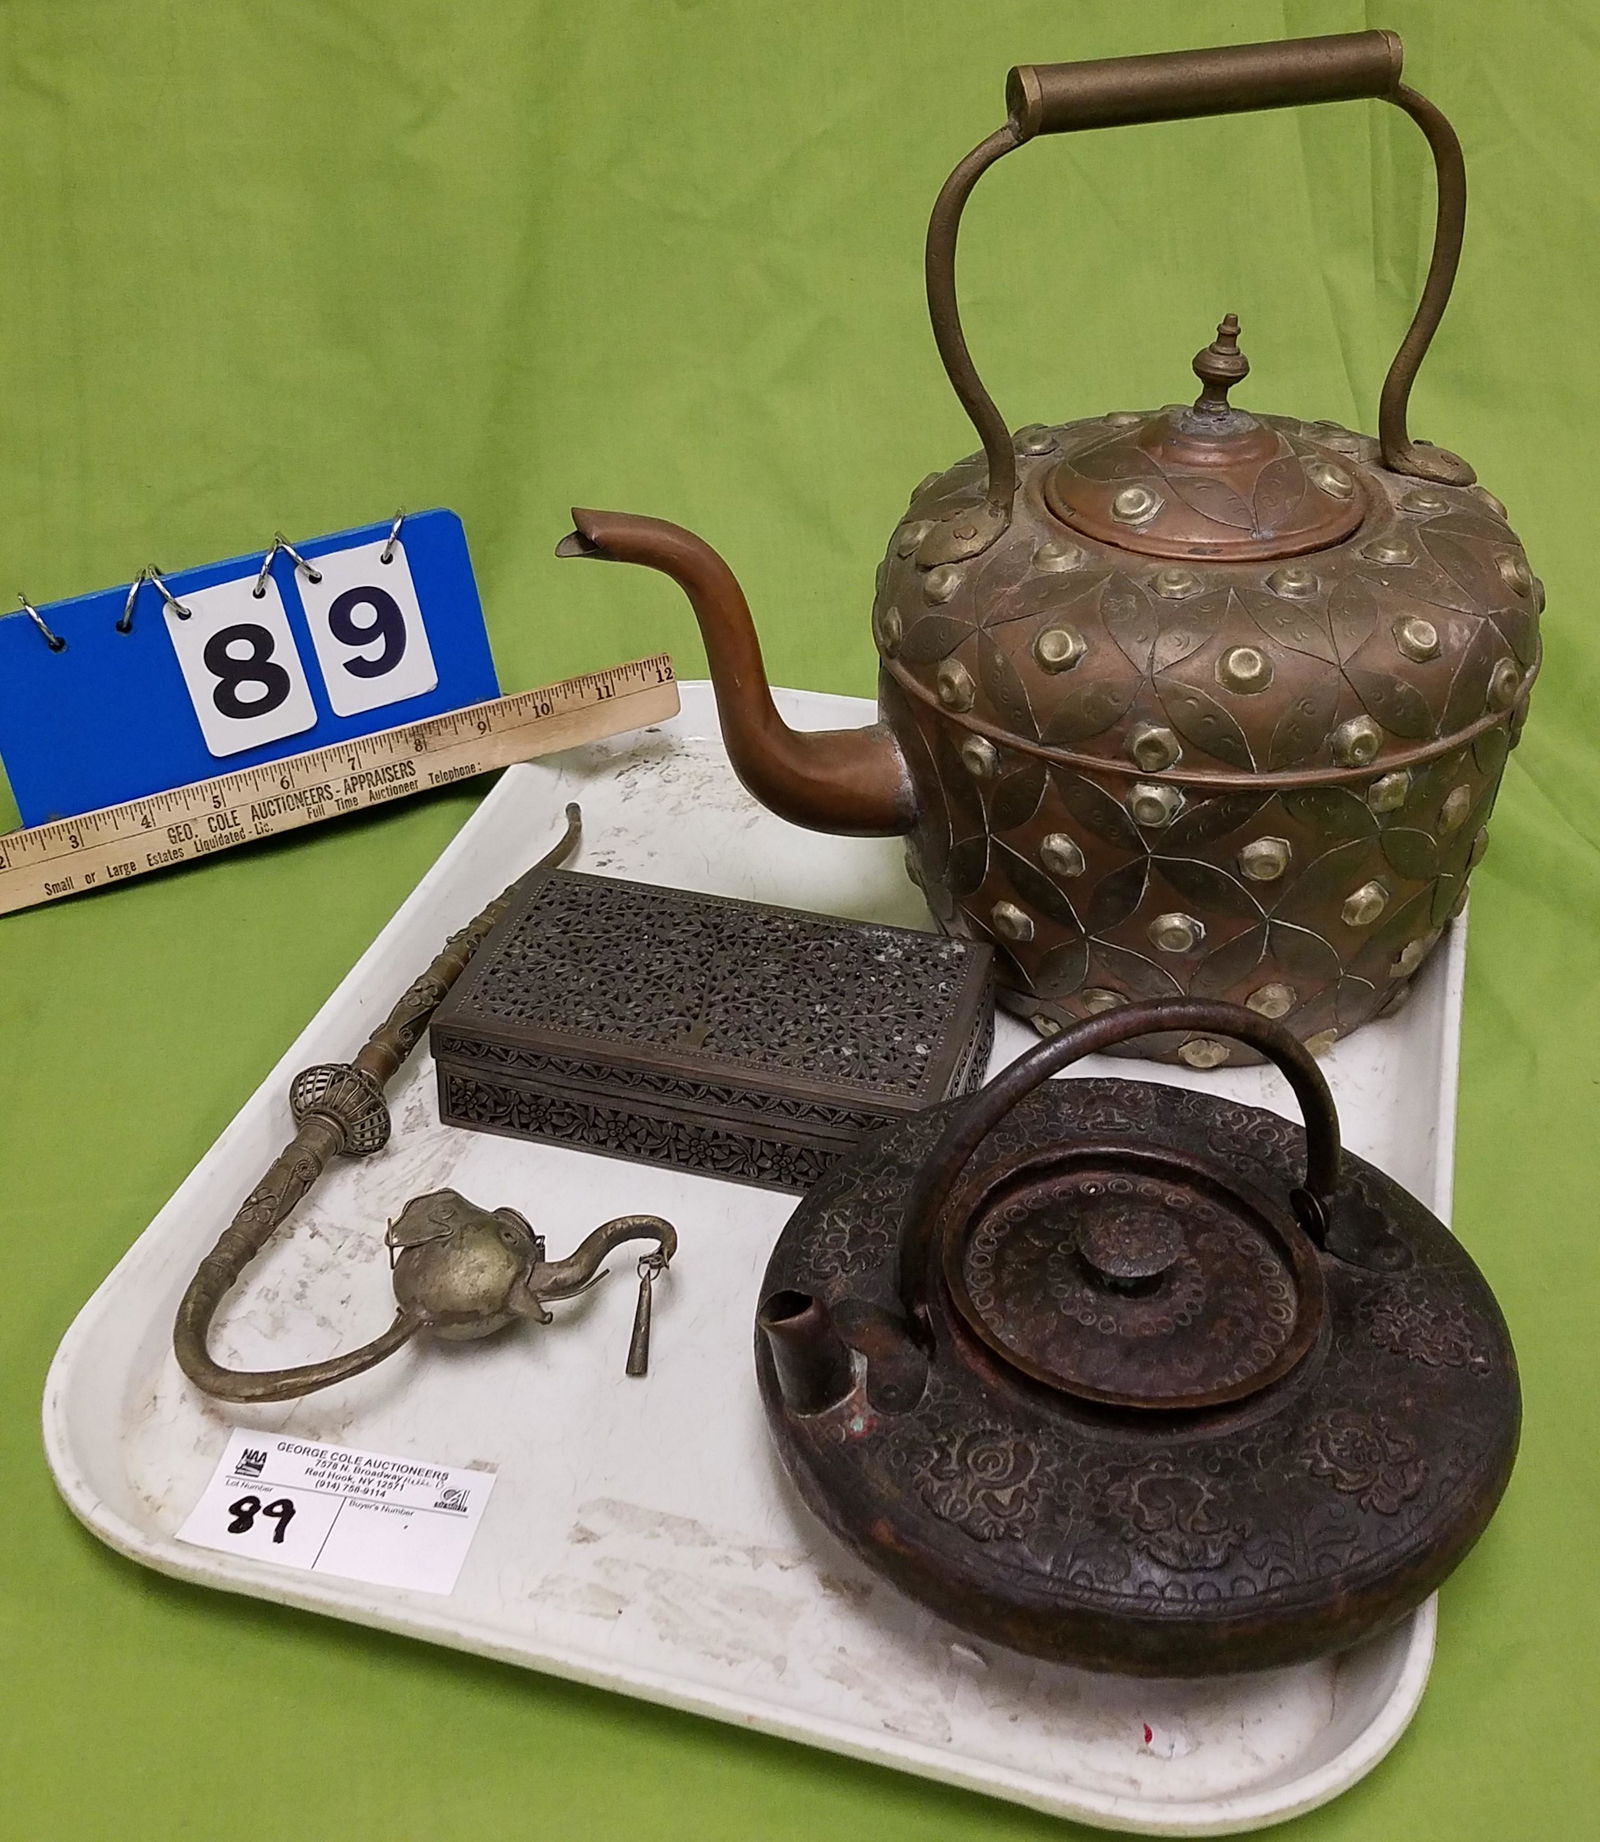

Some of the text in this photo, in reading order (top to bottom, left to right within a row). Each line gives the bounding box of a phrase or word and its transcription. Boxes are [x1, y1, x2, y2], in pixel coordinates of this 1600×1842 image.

[68, 835, 80, 849] 3
[140, 814, 152, 829] 4
[212, 795, 222, 809] 5
[280, 776, 291, 790] 6
[347, 757, 357, 771] 7
[414, 739, 424, 752] 8
[477, 721, 488, 735] 9
[532, 703, 550, 719] 10
[596, 685, 612, 701] 11
[656, 667, 674, 683] 12
[44, 876, 75, 896] Small
[85, 871, 96, 885] or
[106, 860, 137, 878] Large
[147, 847, 185, 867] Estates
[307, 804, 326, 820] Full
[334, 795, 359, 812] Time
[368, 779, 419, 802] Auctioneer
[167, 823, 198, 845] GEO.
[207, 810, 241, 833] COLE
[277, 1441, 449, 1481] GEORGE COLE AUCTIONEERS
[225, 1479, 274, 1492] Lot Number
[305, 1467, 325, 1478] Red
[327, 1471, 356, 1484] Hook,
[358, 1476, 375, 1487] NY
[376, 1480, 405, 1492] 12571
[315, 1479, 341, 1492] (914)
[227, 1495, 296, 1544] 89
[349, 1499, 415, 1516] Buyer's Number
